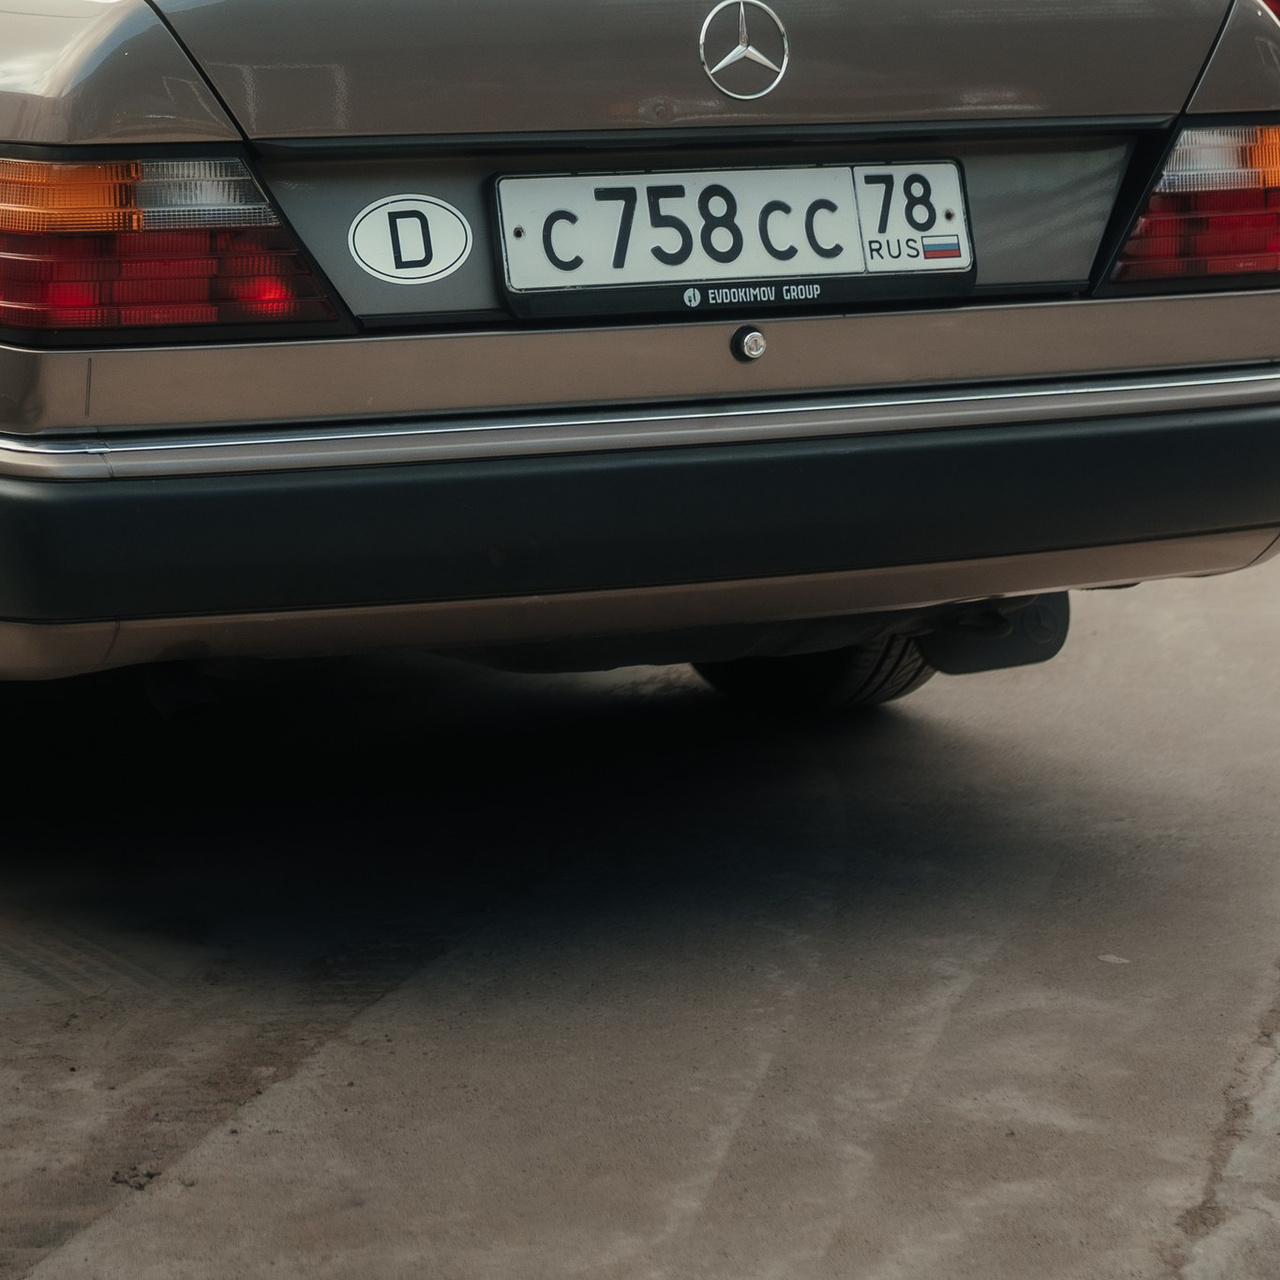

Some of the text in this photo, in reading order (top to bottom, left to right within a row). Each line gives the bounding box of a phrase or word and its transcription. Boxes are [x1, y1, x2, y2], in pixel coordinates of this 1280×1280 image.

[864, 173, 938, 234] 78
[387, 209, 433, 270] D
[869, 238, 920, 260] RUS
[708, 284, 822, 304] EVDOKIMOV GROUP
